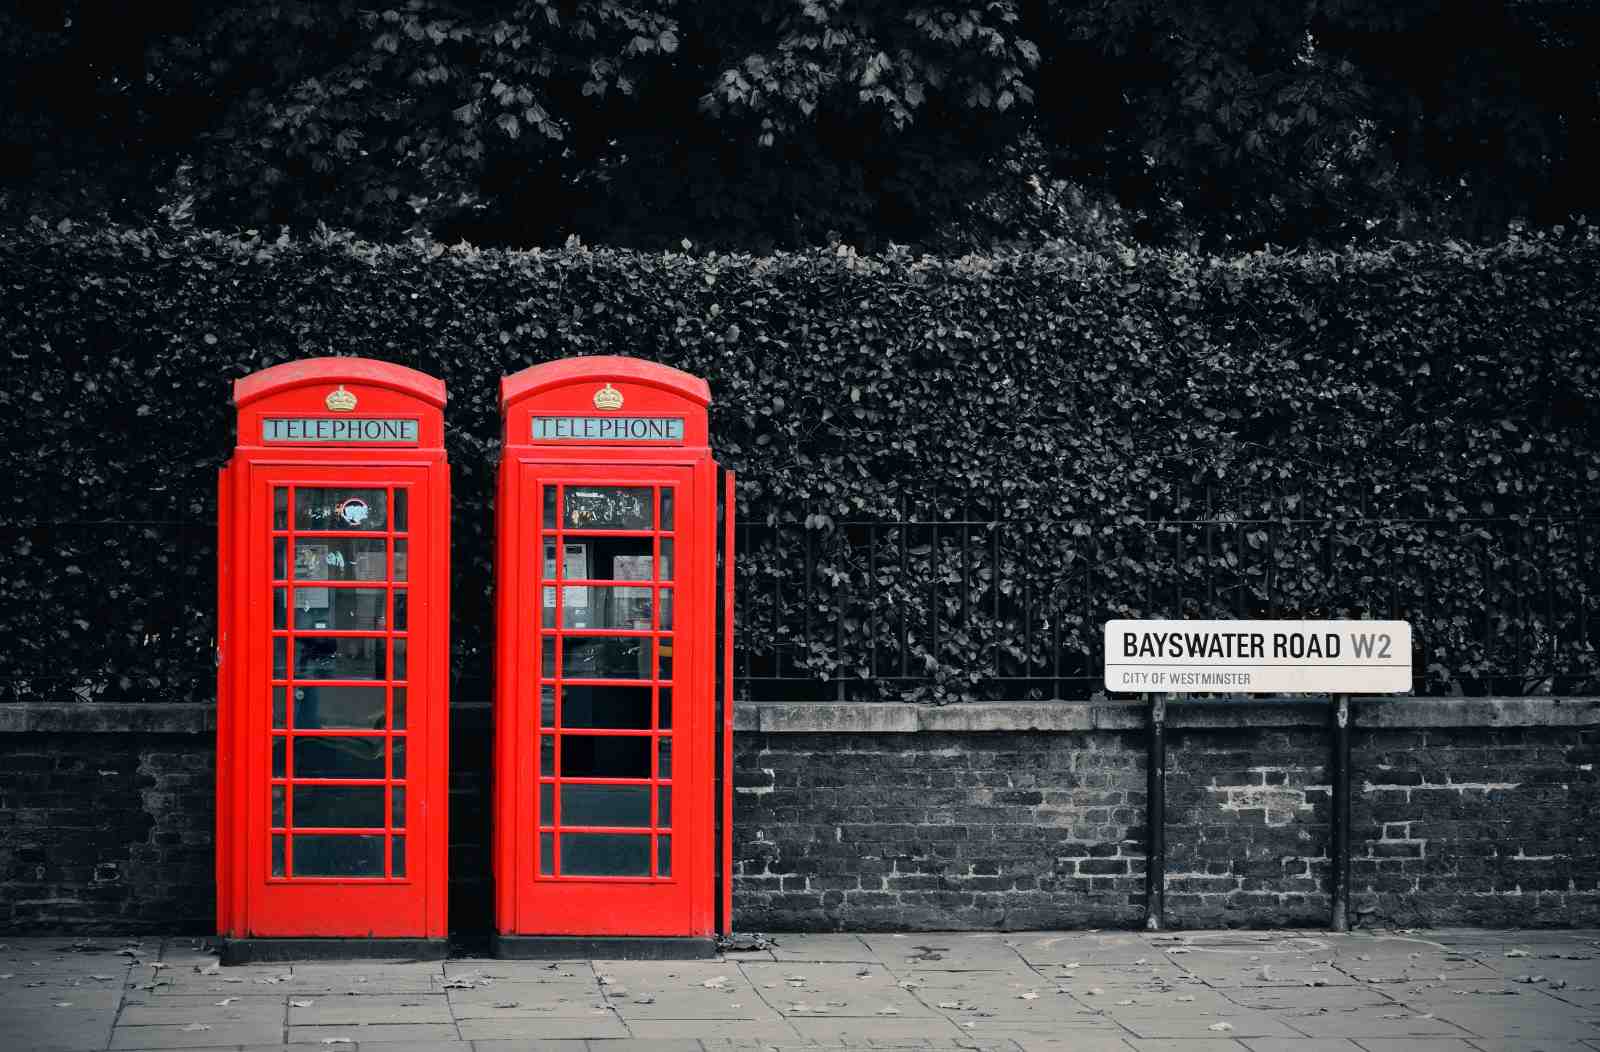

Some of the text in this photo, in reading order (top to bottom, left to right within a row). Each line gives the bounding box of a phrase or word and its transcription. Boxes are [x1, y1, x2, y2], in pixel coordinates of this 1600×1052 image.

[268, 419, 413, 440] TELEPHONE
[538, 417, 678, 439] TELEPHONE
[1123, 632, 1392, 659] BAYSWATER ROAD W2
[1122, 672, 1251, 685] CITY OF WESTMINSTER
